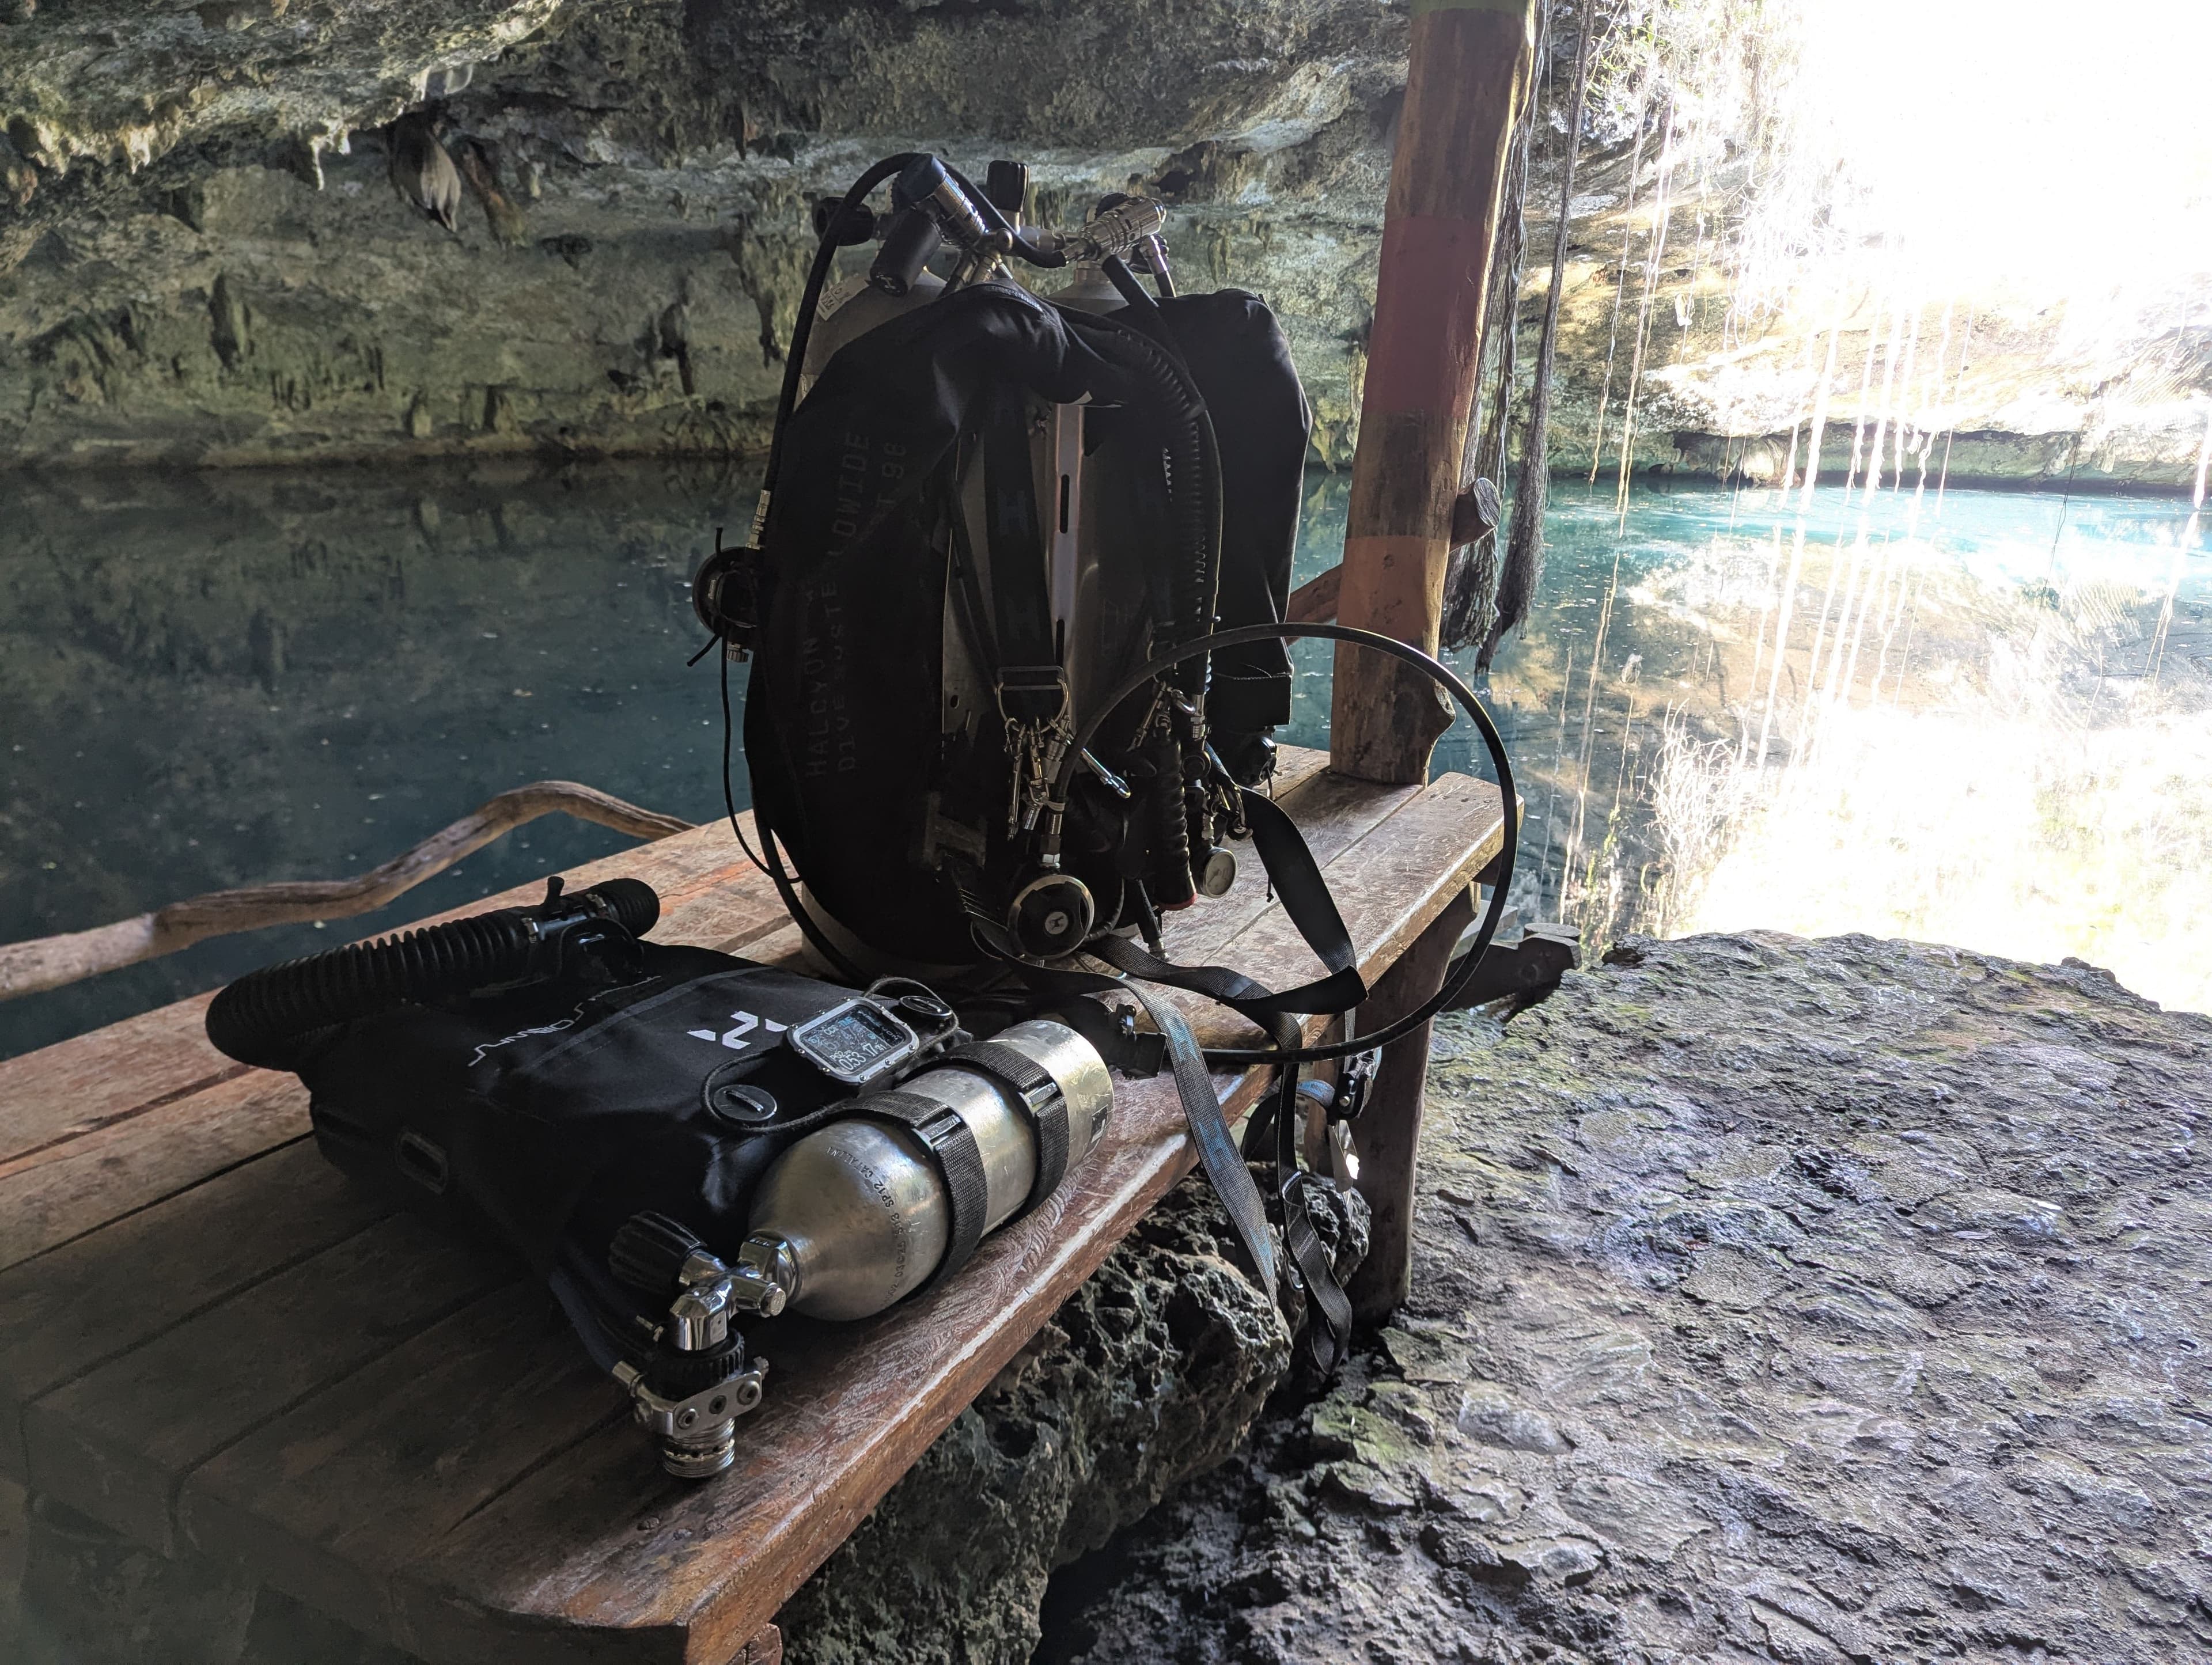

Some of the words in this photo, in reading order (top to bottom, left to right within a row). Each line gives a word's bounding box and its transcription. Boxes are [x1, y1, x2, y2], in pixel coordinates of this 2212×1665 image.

[803, 636, 828, 776] HALCYON
[832, 695, 856, 772] DIVE
[874, 1180, 895, 1208] SP12
